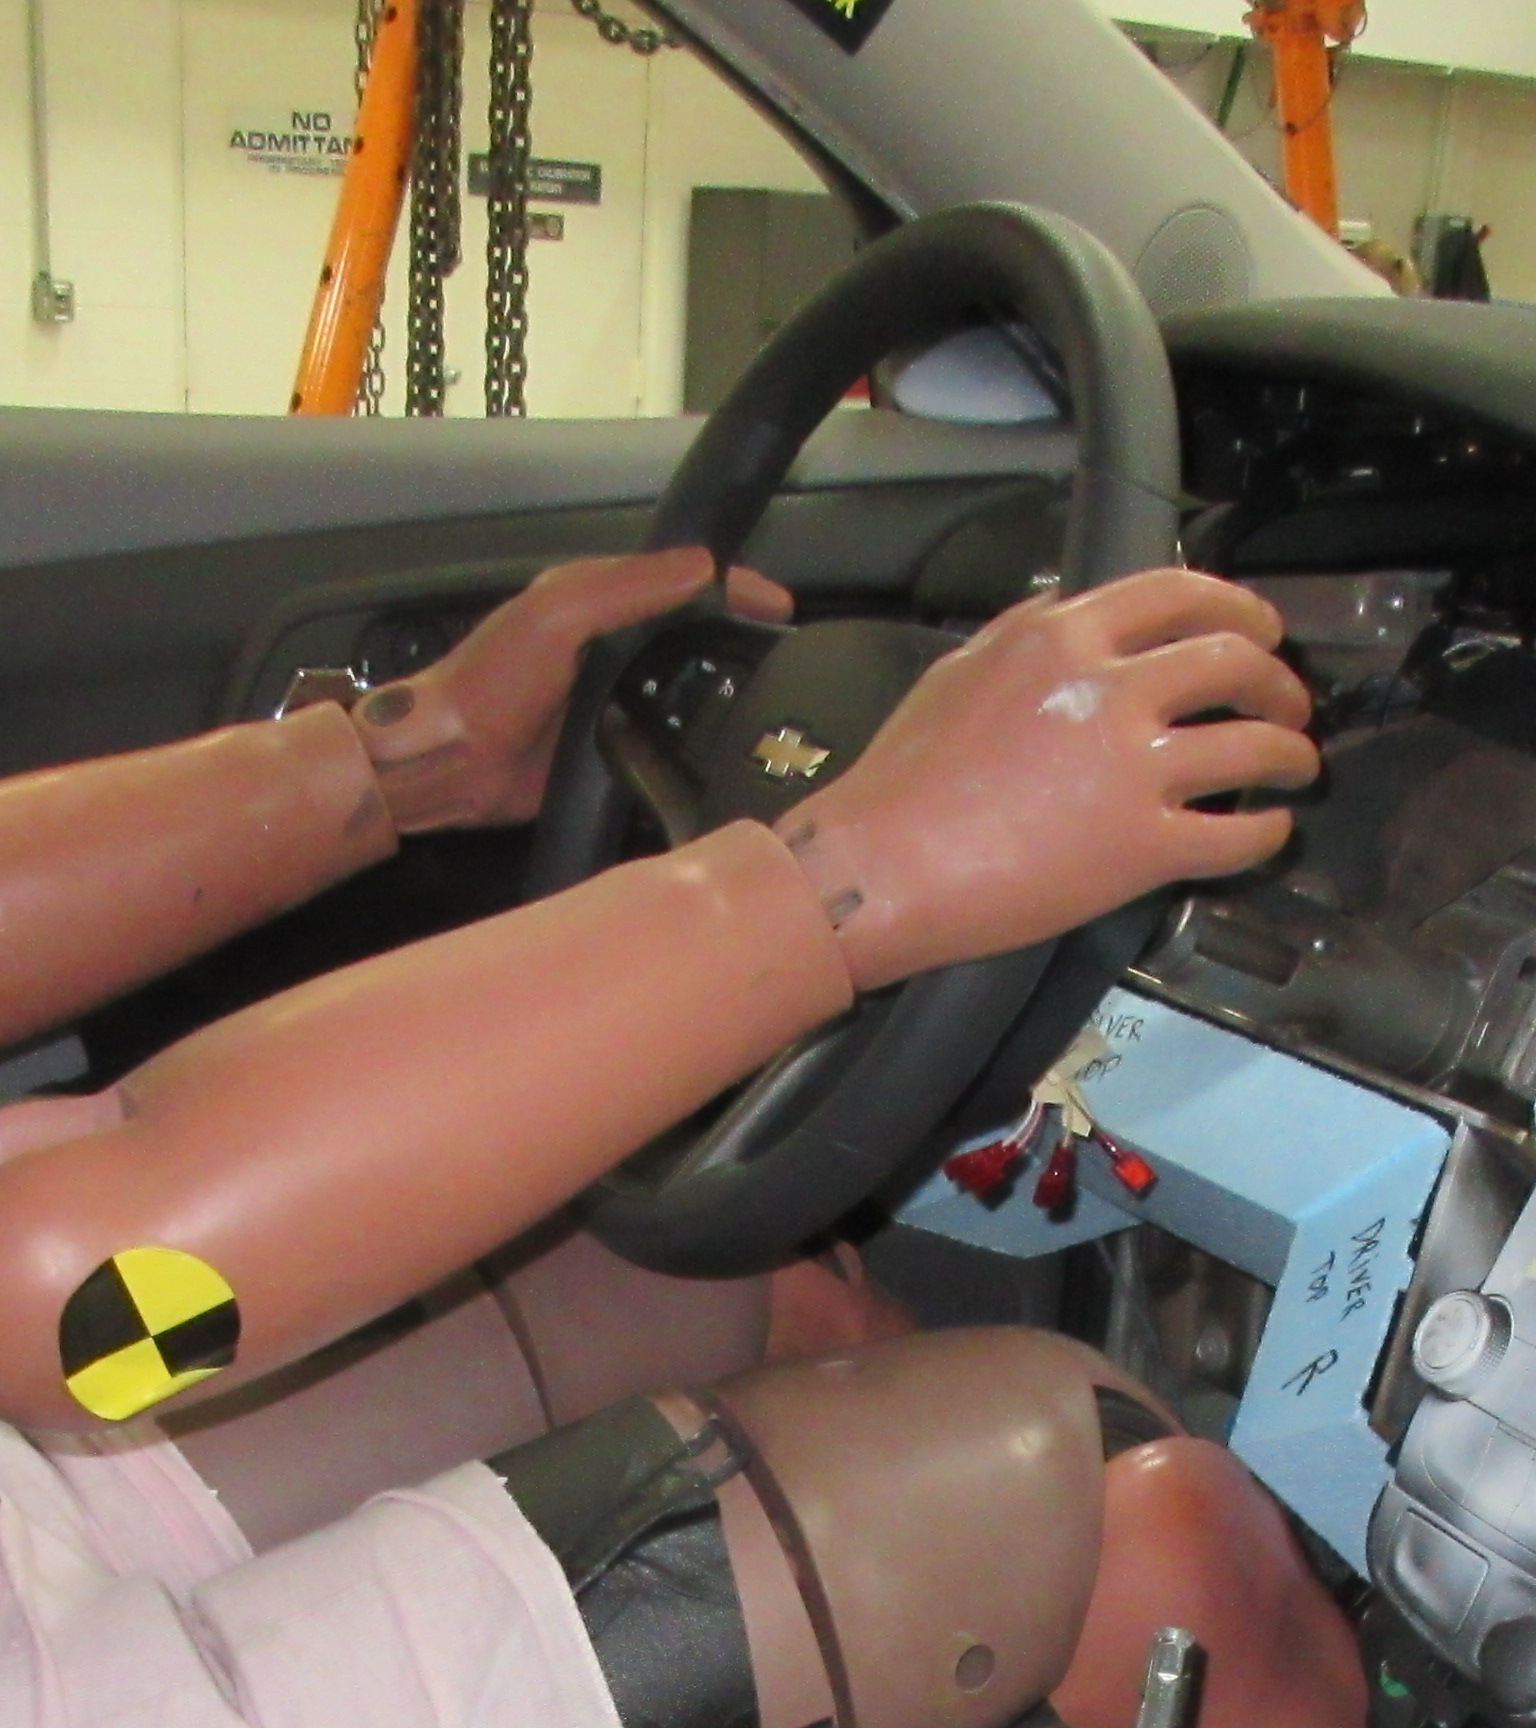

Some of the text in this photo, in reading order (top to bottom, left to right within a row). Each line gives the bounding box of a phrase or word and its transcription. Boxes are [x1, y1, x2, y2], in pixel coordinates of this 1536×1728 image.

[291, 111, 332, 131] NO
[229, 129, 356, 155] ADMITTAN
[1280, 1348, 1340, 1397] R
